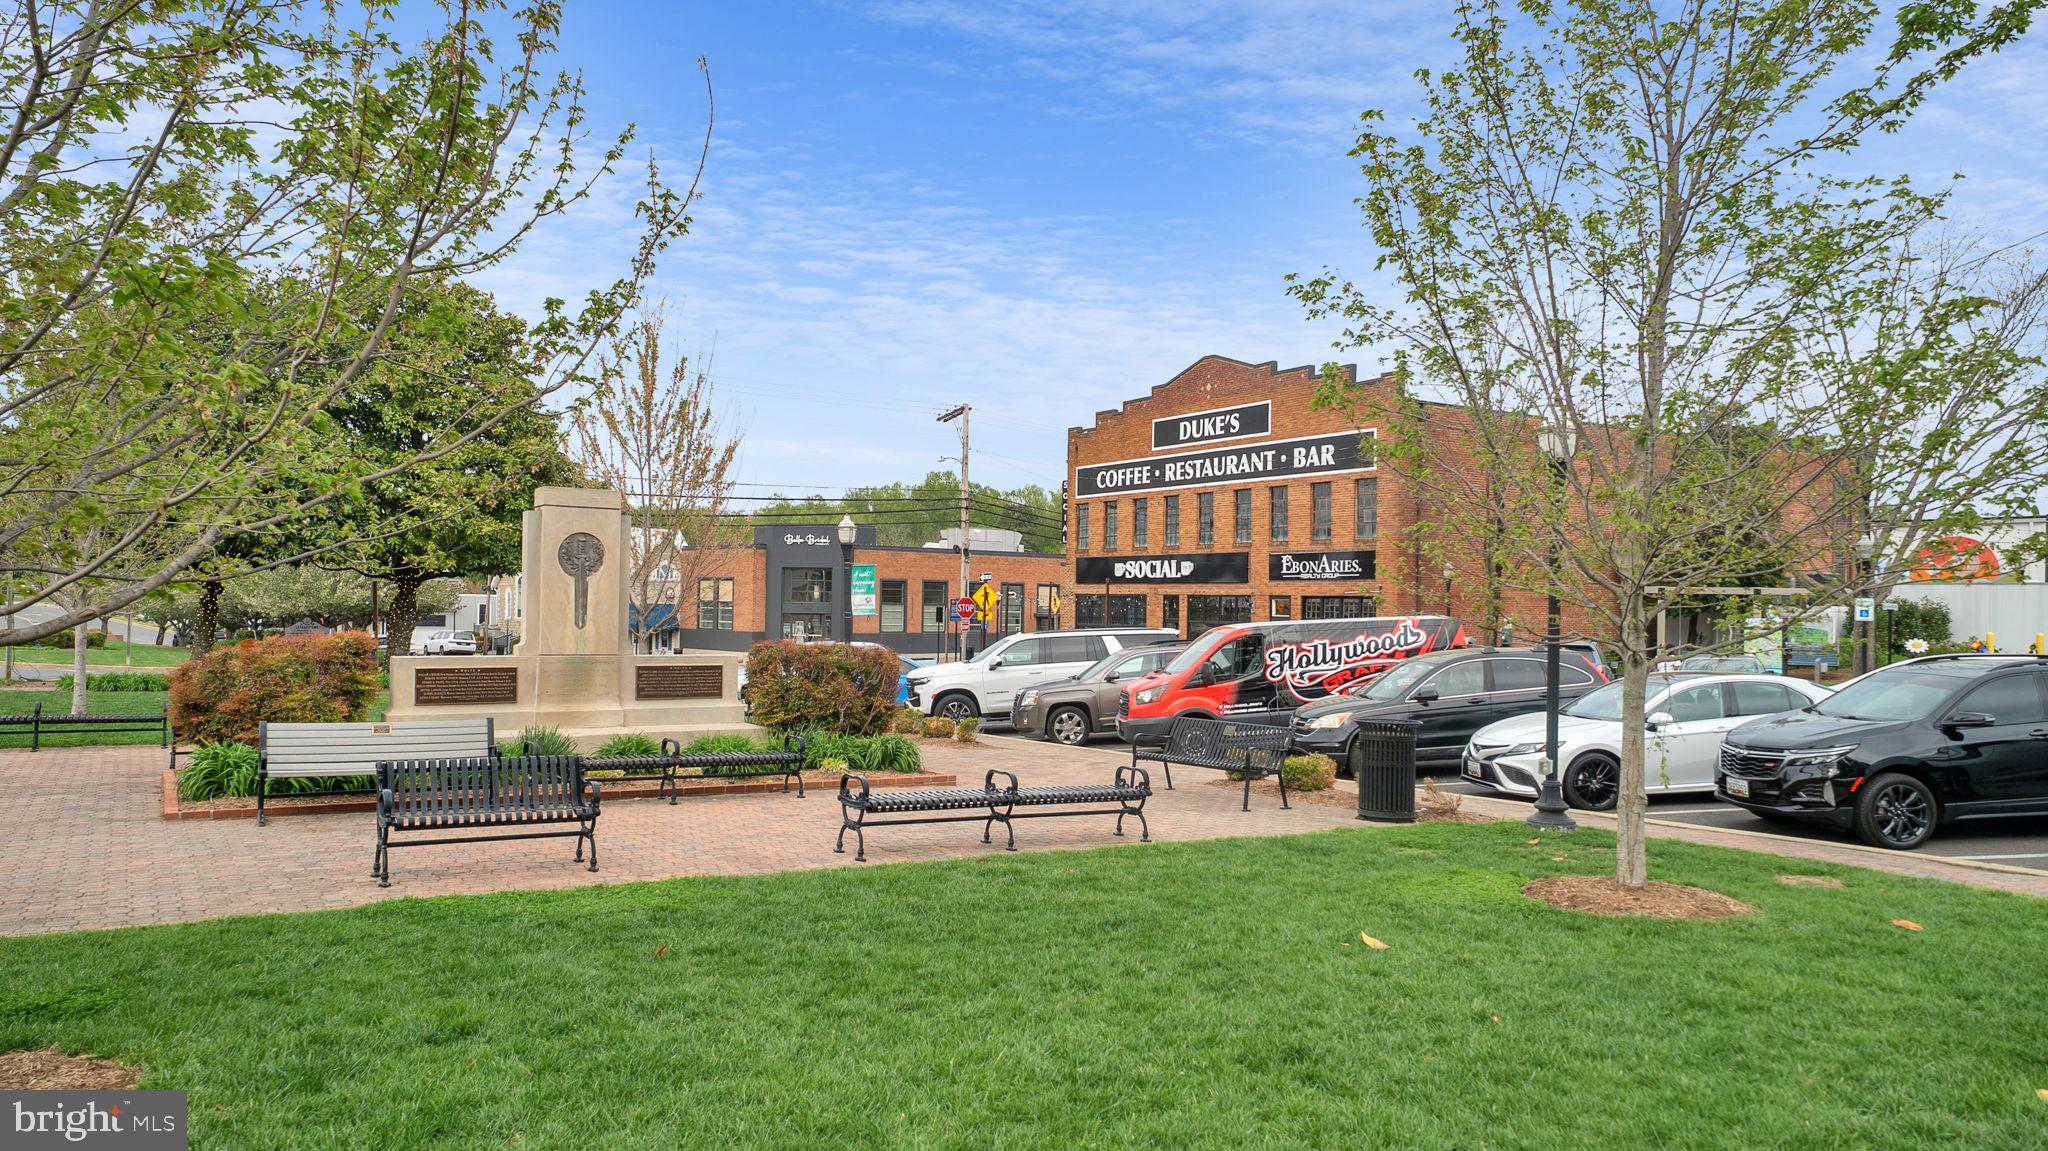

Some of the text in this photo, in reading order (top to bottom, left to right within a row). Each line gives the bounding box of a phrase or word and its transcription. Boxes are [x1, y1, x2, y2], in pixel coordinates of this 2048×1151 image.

[1179, 412, 1240, 441] DUKE'S
[1096, 444, 1336, 489] COFFEE RESTAURANT BAR
[1124, 559, 1182, 579] SOCIAL
[957, 603, 975, 613] STOP
